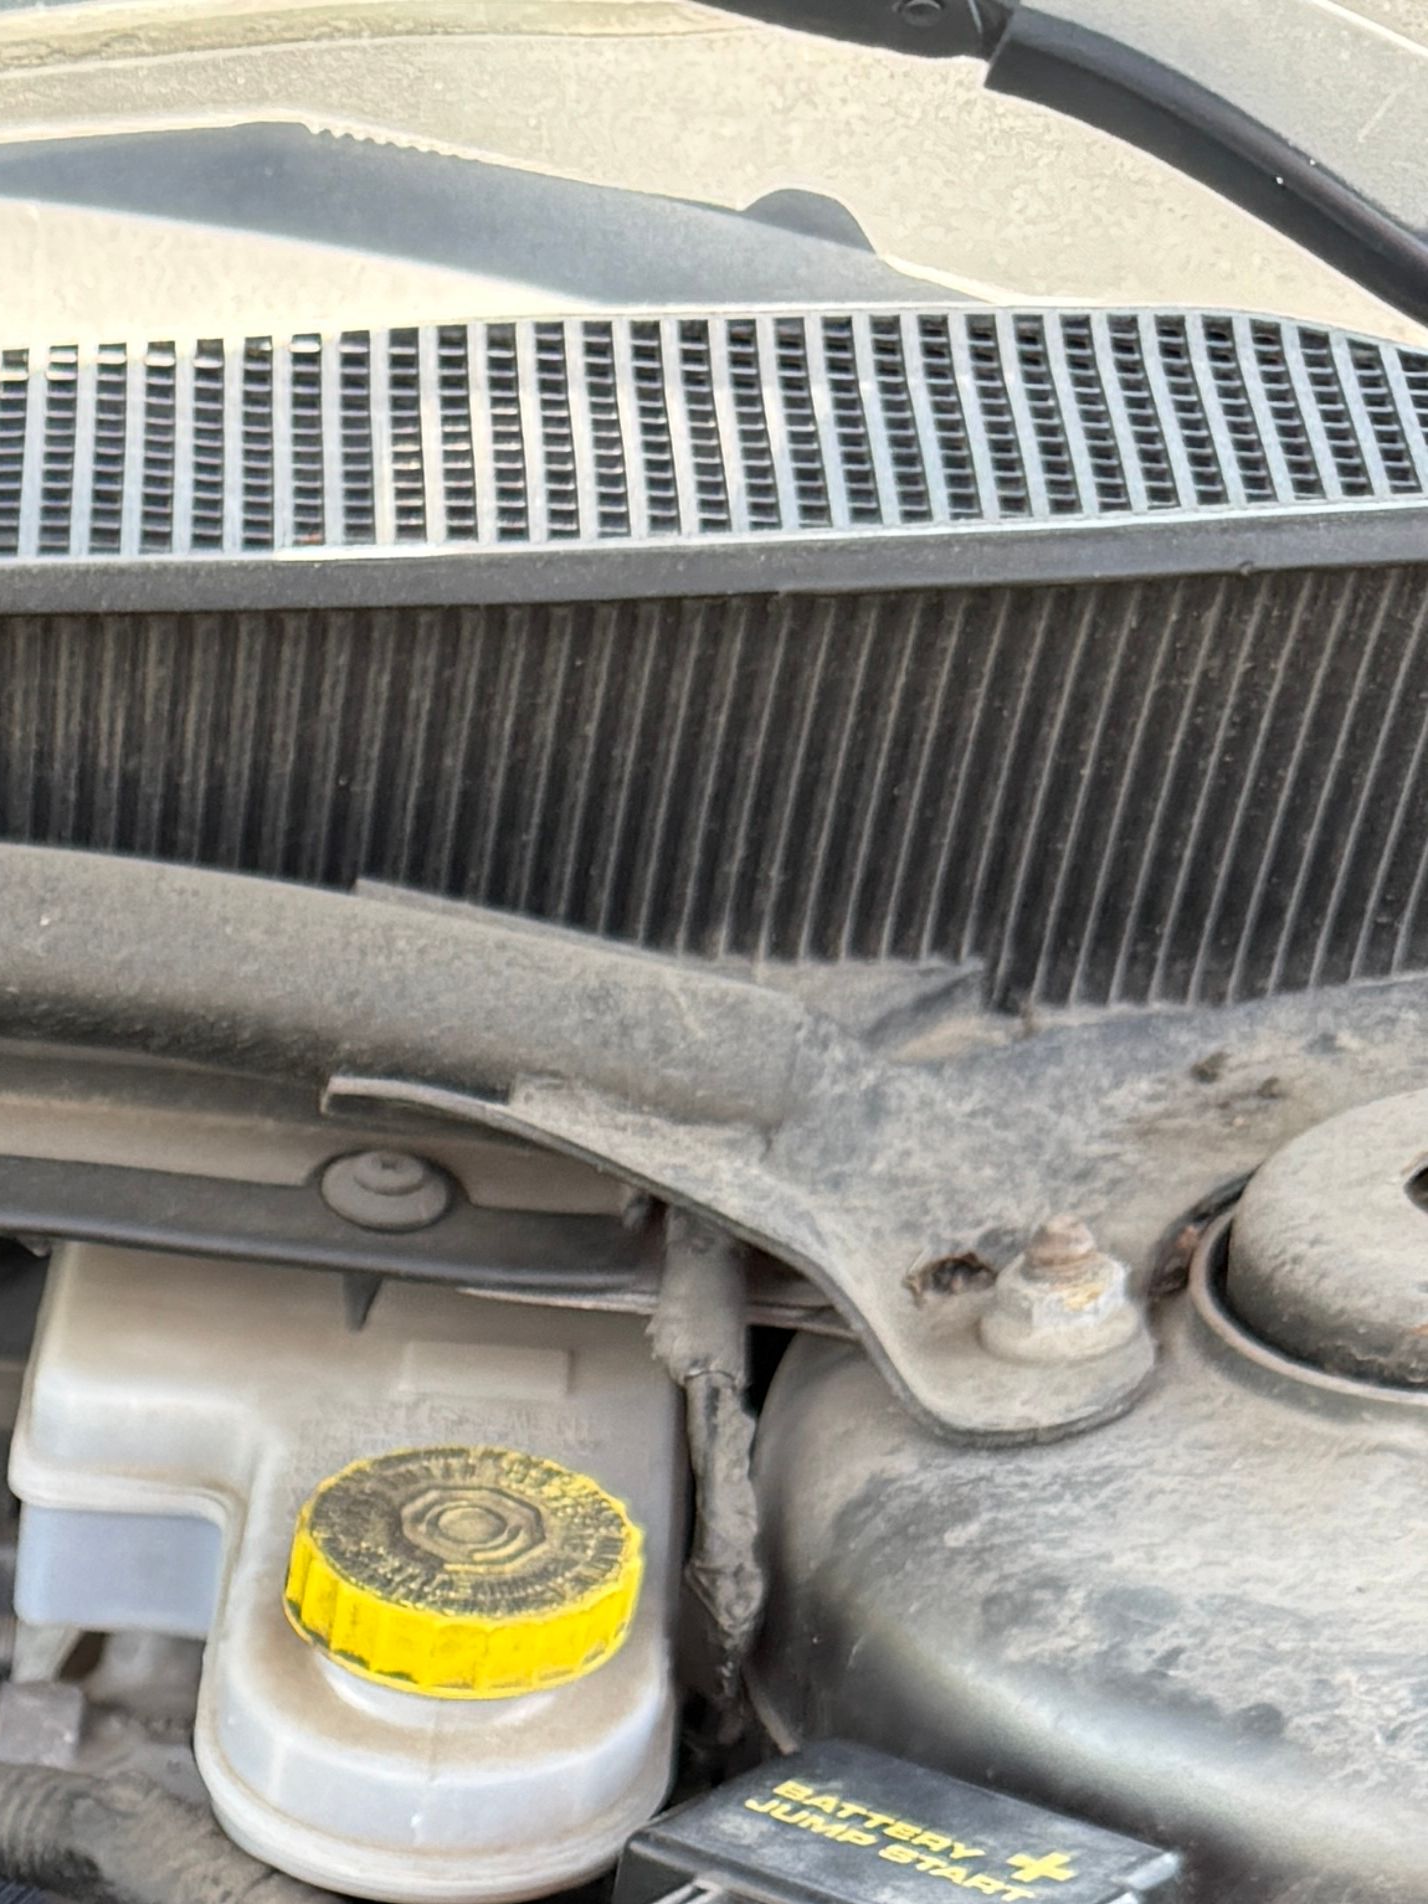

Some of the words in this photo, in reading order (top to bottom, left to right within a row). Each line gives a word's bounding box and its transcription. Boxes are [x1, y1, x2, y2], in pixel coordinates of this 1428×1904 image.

[745, 1799, 878, 1846] JUMP
[878, 1845, 1036, 1902] START
[772, 1780, 986, 1860] BATTERY
